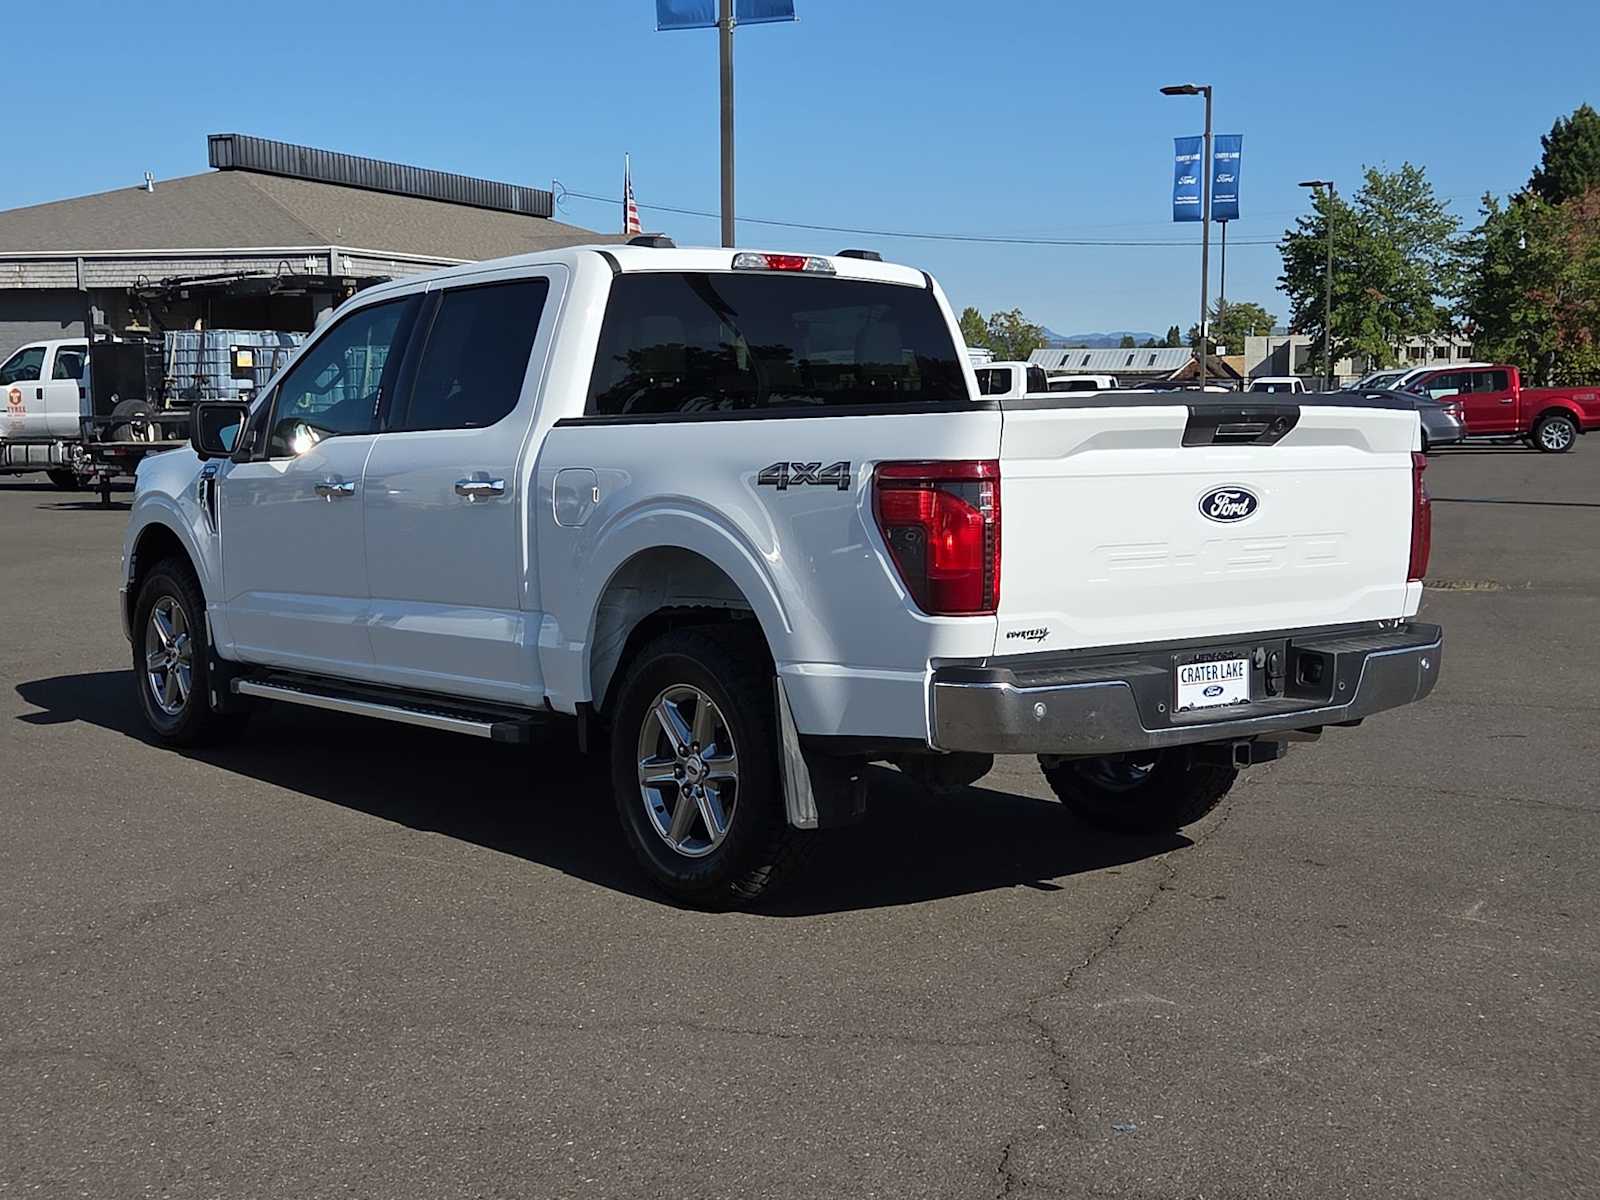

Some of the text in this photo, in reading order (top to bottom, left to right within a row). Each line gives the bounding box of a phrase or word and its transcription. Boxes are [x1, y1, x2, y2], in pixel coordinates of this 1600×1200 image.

[1178, 175, 1197, 184] Ford
[1216, 173, 1235, 183] Ford
[1210, 492, 1249, 516] Ford
[1181, 661, 1244, 683] CRATER LAKE
